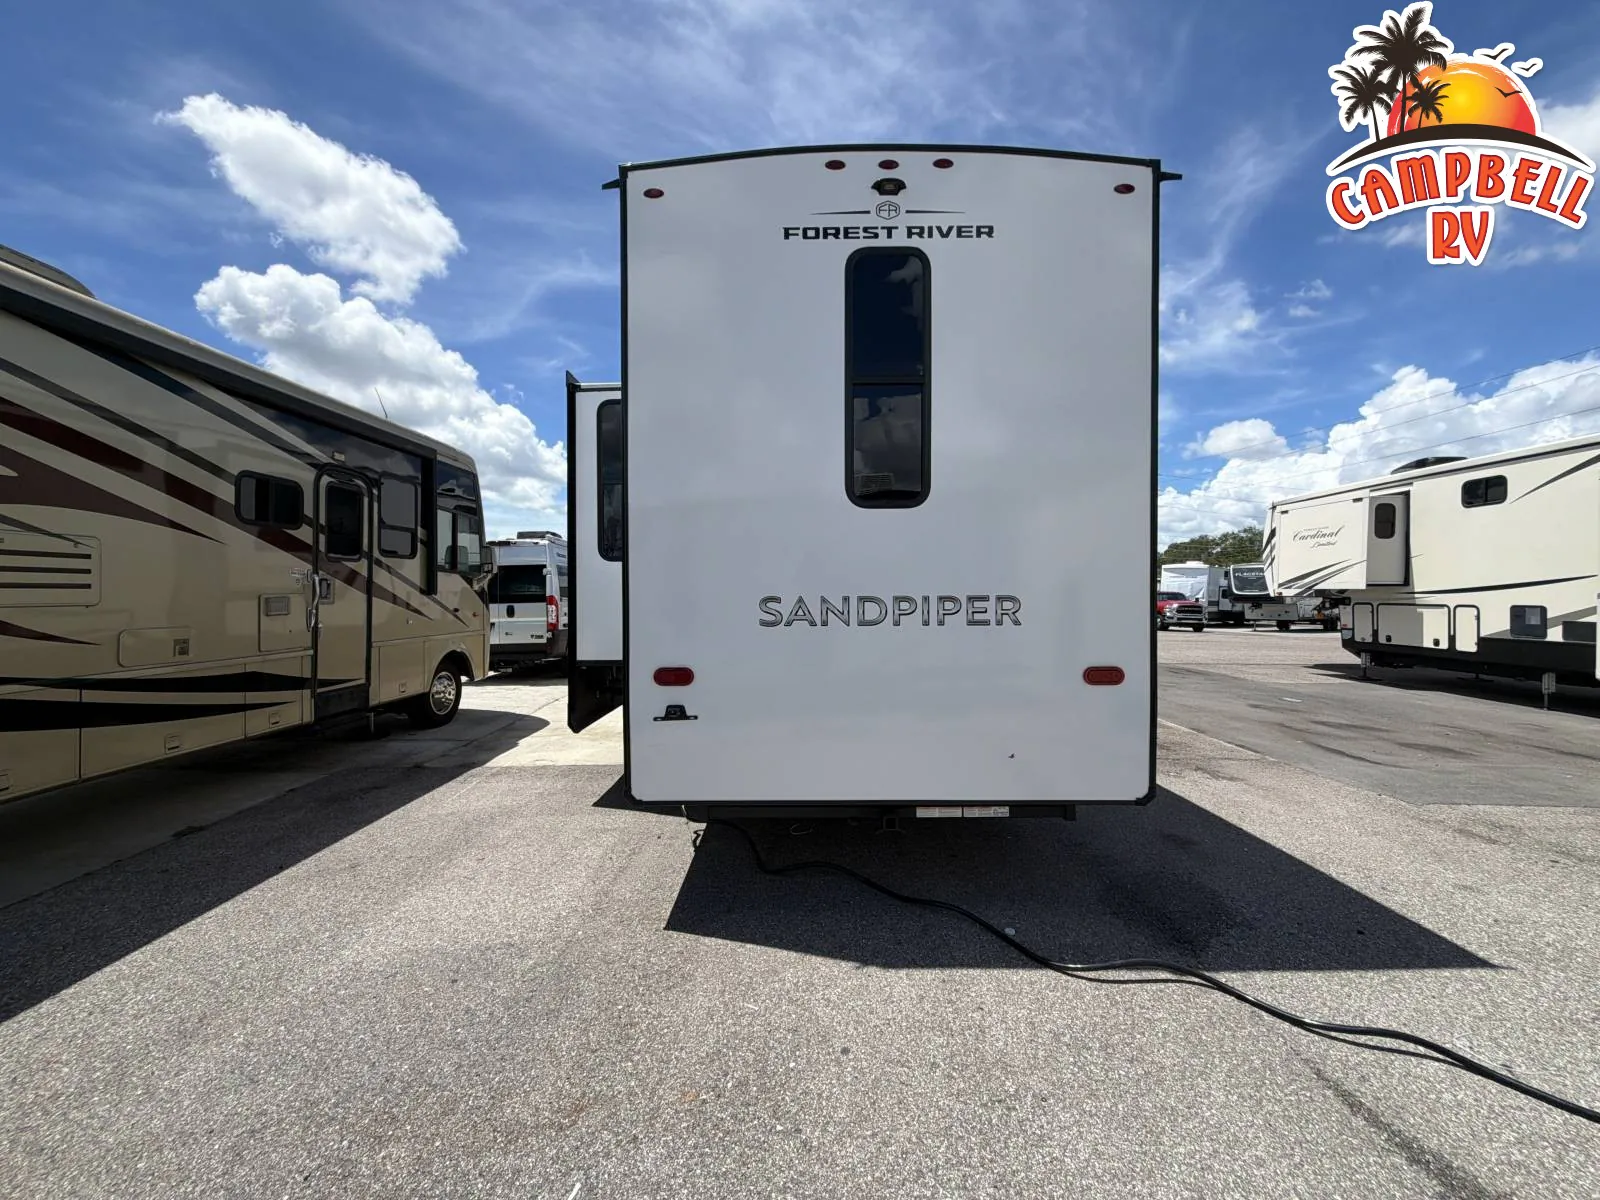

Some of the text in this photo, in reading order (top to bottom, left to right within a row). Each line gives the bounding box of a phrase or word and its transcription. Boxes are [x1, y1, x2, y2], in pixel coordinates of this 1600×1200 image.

[782, 225, 995, 240] FOREST RIVER
[1292, 525, 1345, 541] Cardinal
[758, 594, 1021, 627] SANDPIPER
